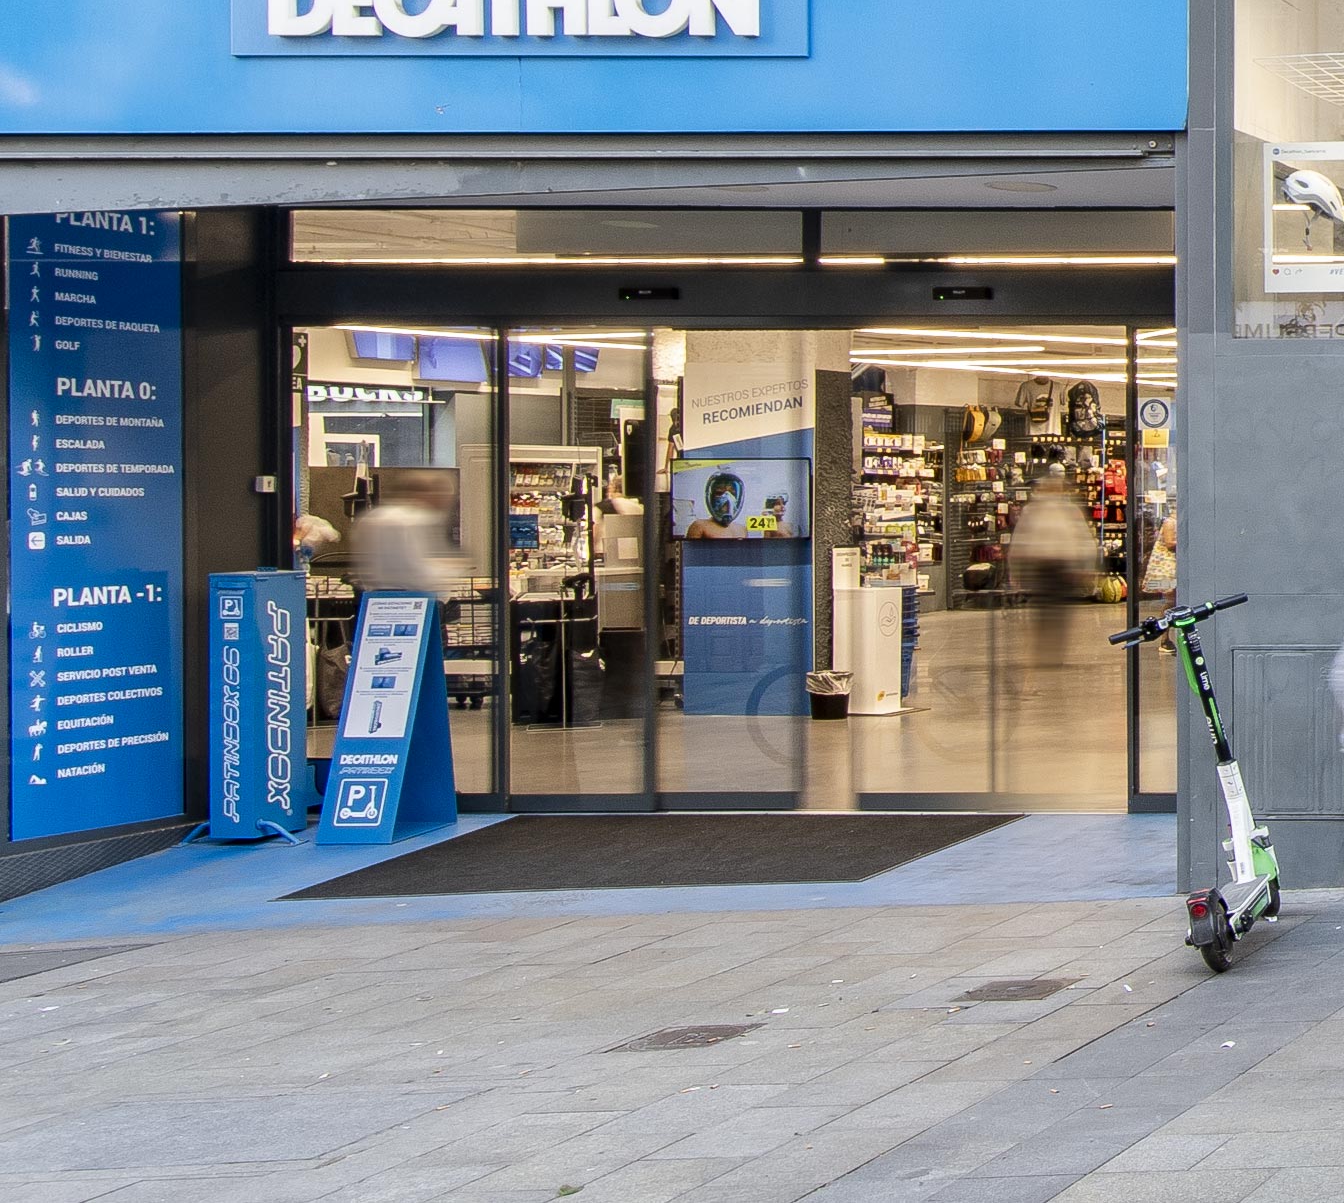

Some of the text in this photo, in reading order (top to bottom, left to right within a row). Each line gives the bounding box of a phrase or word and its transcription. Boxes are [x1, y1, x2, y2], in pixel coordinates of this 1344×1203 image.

[139, 216, 155, 235] 1:
[54, 243, 153, 263] FITNESS Y BIENESTAR
[55, 268, 98, 280] RUNNING
[55, 292, 97, 304] MARCHA
[55, 316, 160, 333] DEPORTES DE RAQUETA
[55, 340, 80, 350] GOLF
[57, 377, 157, 400] PLANTA 0:
[691, 378, 809, 409] NUESTROS EXPERTOS
[702, 396, 804, 425] RECOMIENDAN
[55, 415, 165, 427] DEPORTES DE MONTAÑA
[55, 439, 105, 449] ESCALADA
[55, 463, 174, 474] DEPORTES DE TEMPORADA
[55, 487, 145, 497] SALUD Y CUIDADOS
[55, 511, 88, 521] CAJAS
[56, 535, 91, 545] SALIDA
[53, 584, 163, 607] PLANTA -1:
[688, 616, 699, 625] DE
[700, 616, 747, 626] DEPORTISTA
[56, 622, 104, 633] CICLISMO
[56, 646, 94, 658] ROLLER
[56, 664, 158, 682] SERVICIO POST VENTA
[56, 687, 163, 706] DEPORTES COLECTIVOS
[57, 714, 114, 730] EQUITACIÓN
[57, 731, 169, 755] DEPORTES DE PRECISIÓN
[340, 754, 399, 765] DECATHLON
[57, 762, 106, 778] NATACIÓN
